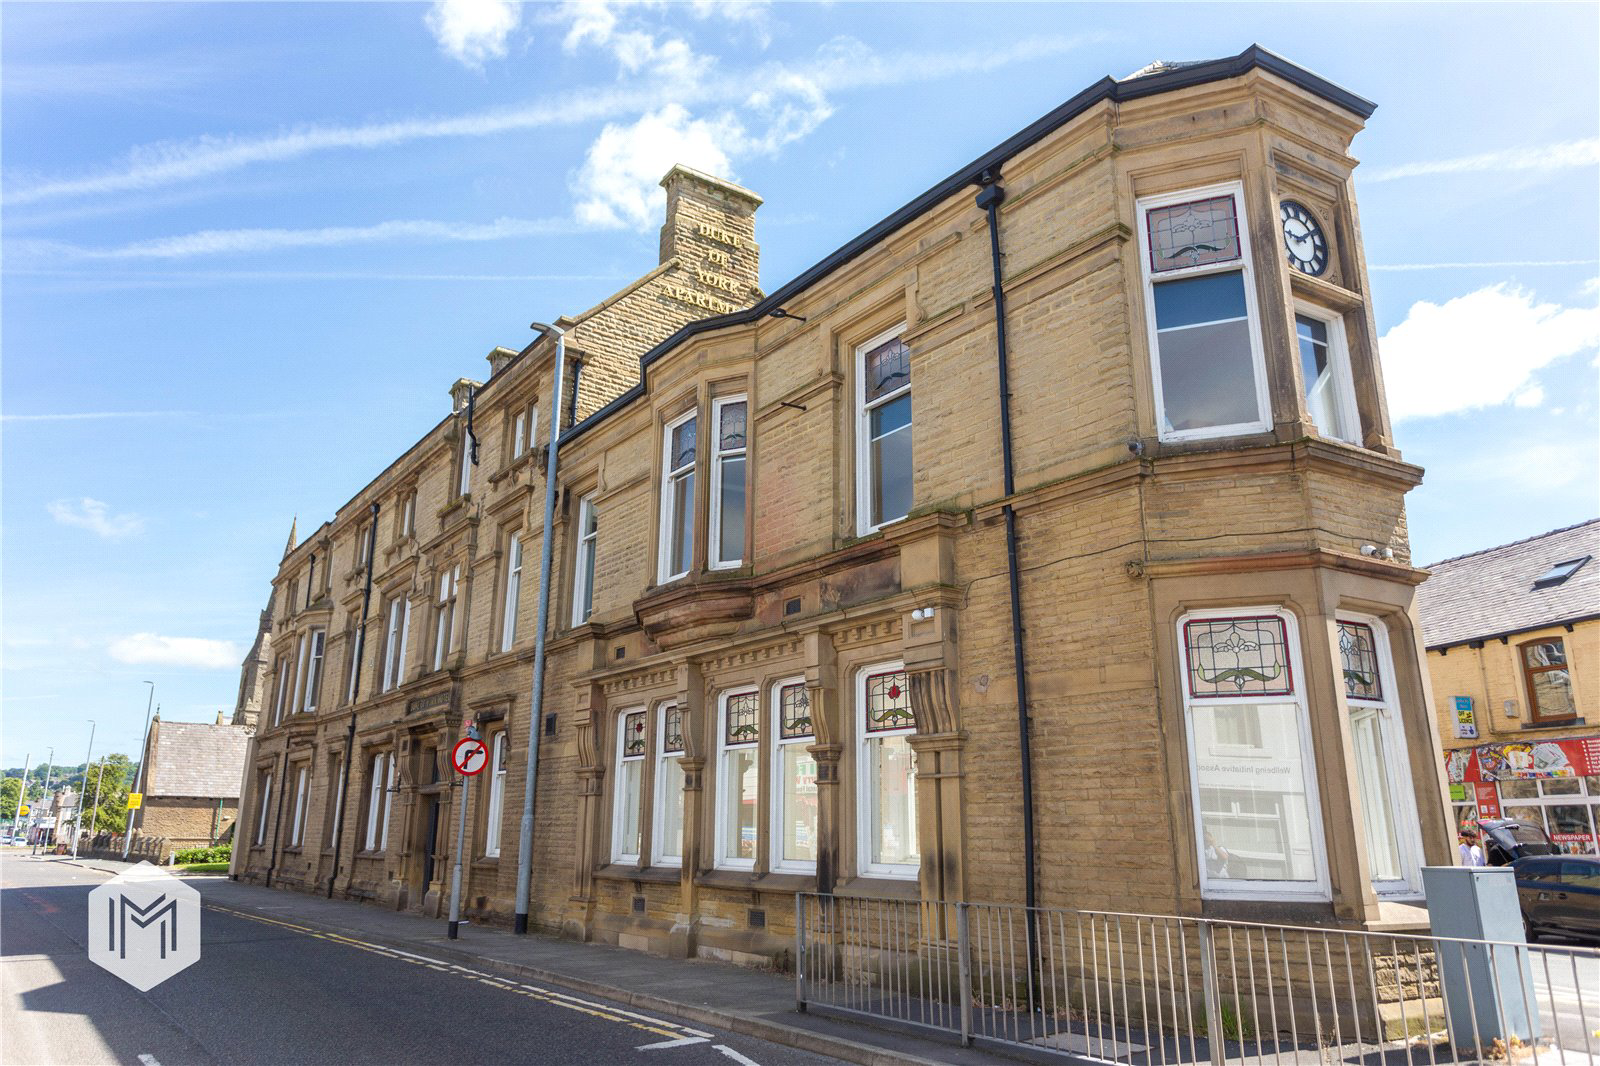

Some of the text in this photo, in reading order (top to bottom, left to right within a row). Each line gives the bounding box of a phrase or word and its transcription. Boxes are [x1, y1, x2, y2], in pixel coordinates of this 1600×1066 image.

[698, 223, 742, 248] DUKE
[708, 250, 730, 268] OF
[696, 267, 741, 297] YORK
